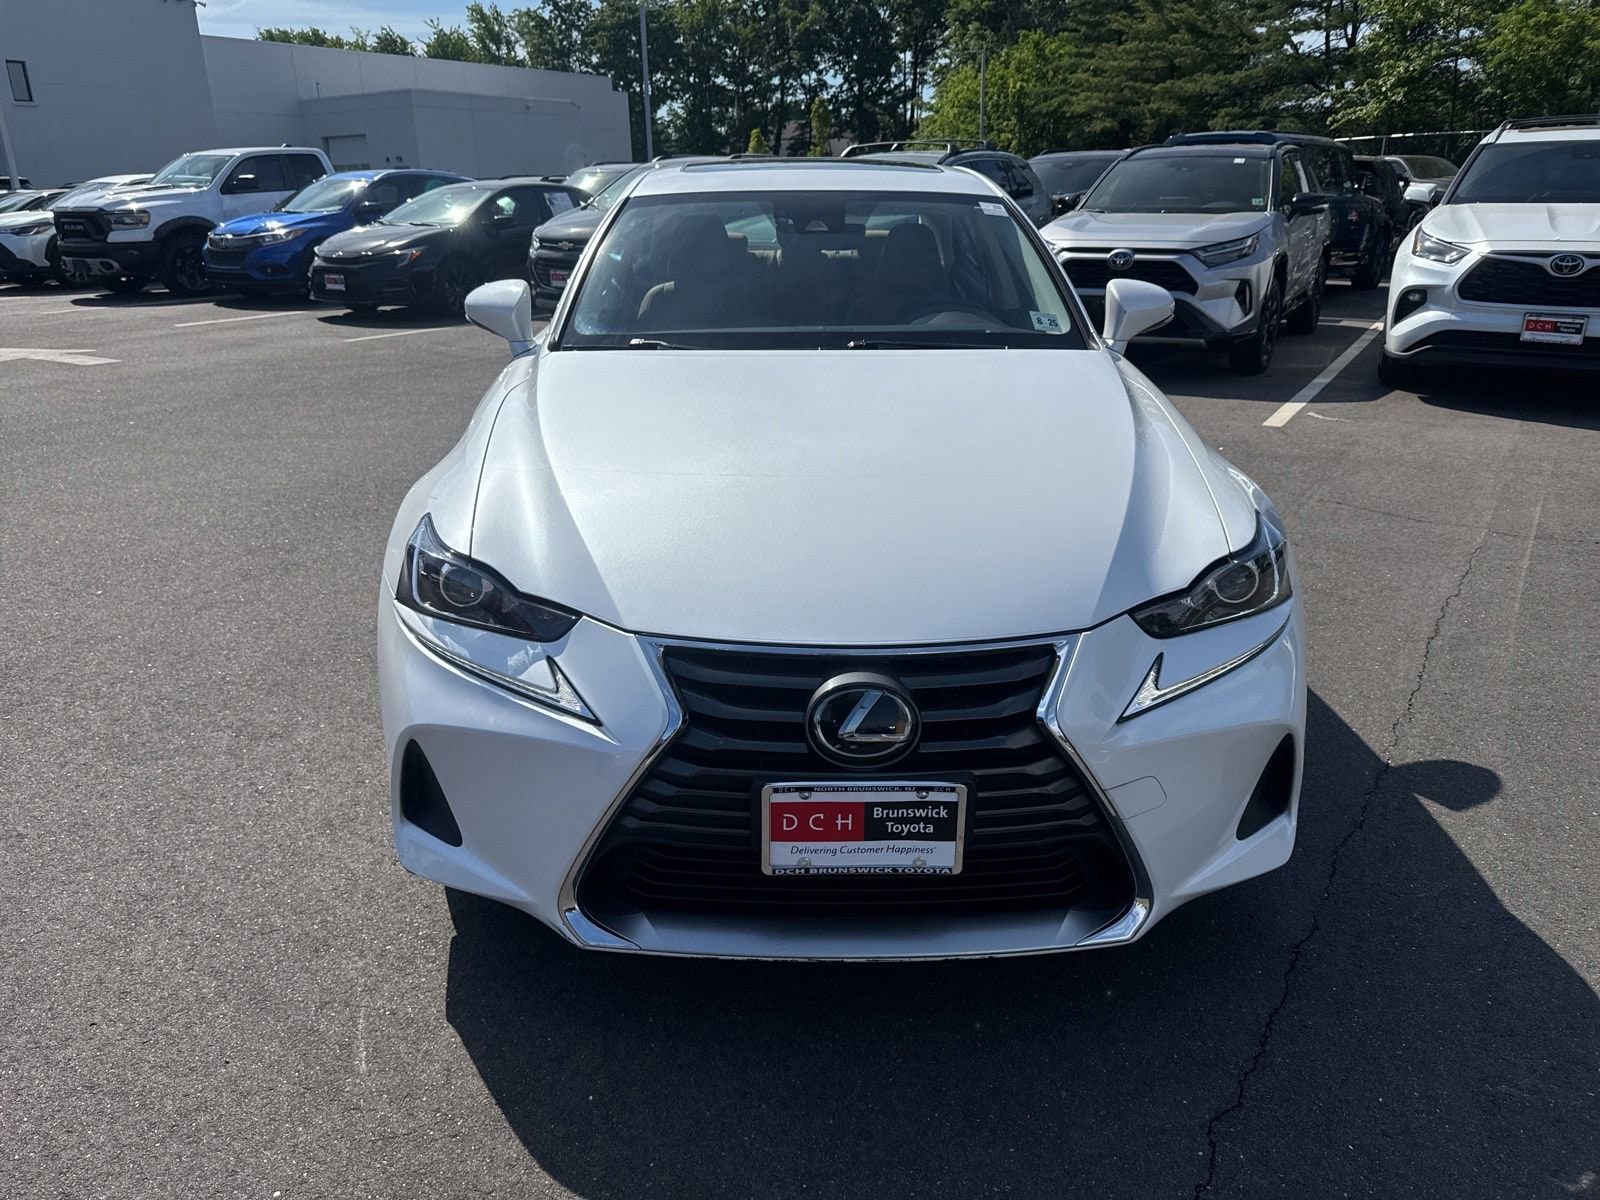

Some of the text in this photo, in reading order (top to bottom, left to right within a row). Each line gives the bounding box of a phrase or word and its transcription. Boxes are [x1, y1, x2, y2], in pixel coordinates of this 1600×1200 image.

[1036, 316, 1058, 328] 8 25
[873, 805, 948, 819] Brunswick
[885, 821, 934, 837] Toyota
[790, 845, 838, 857] Delivering
[839, 844, 884, 855] Customer
[774, 867, 805, 875] DCH
